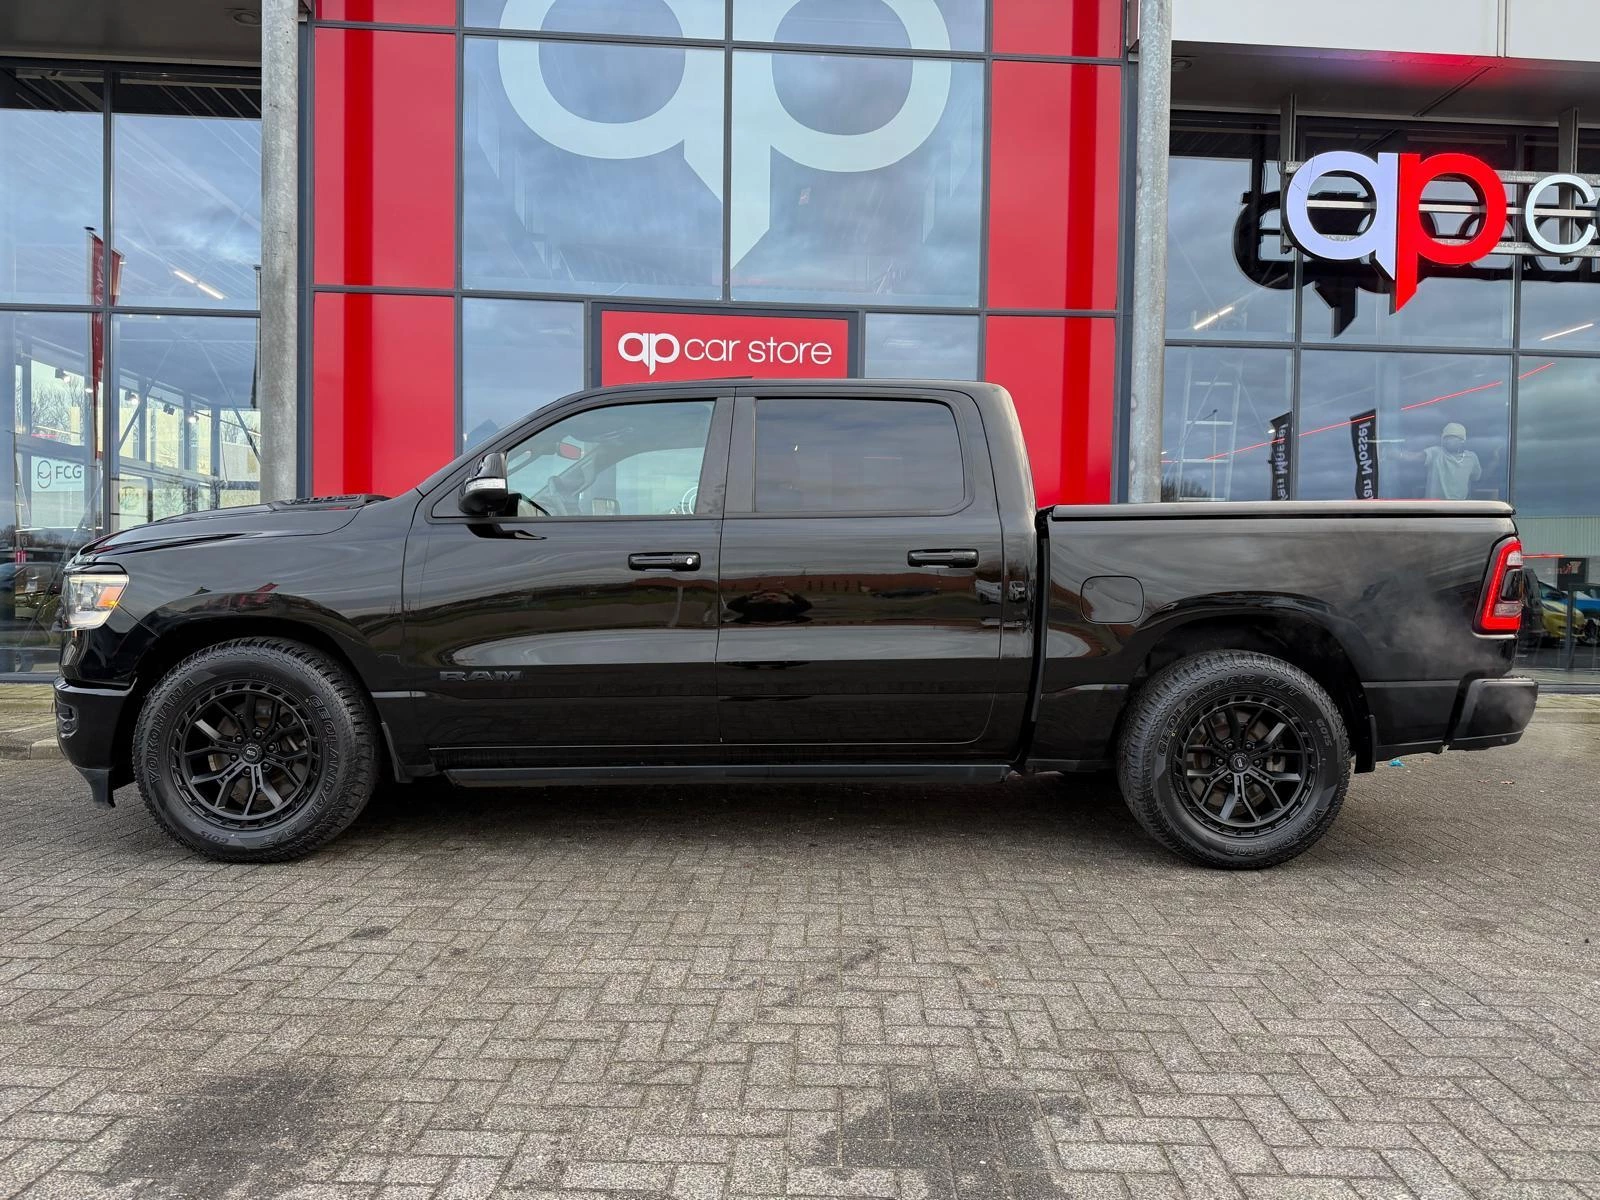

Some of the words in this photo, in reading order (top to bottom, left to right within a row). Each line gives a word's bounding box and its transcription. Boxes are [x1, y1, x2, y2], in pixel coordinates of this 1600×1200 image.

[1286, 151, 1507, 312] ap
[617, 332, 680, 376] ap
[684, 338, 741, 362] car
[747, 336, 833, 365] store
[55, 465, 82, 480] FCG
[439, 670, 522, 681] RAM
[1262, 676, 1304, 698] A/T
